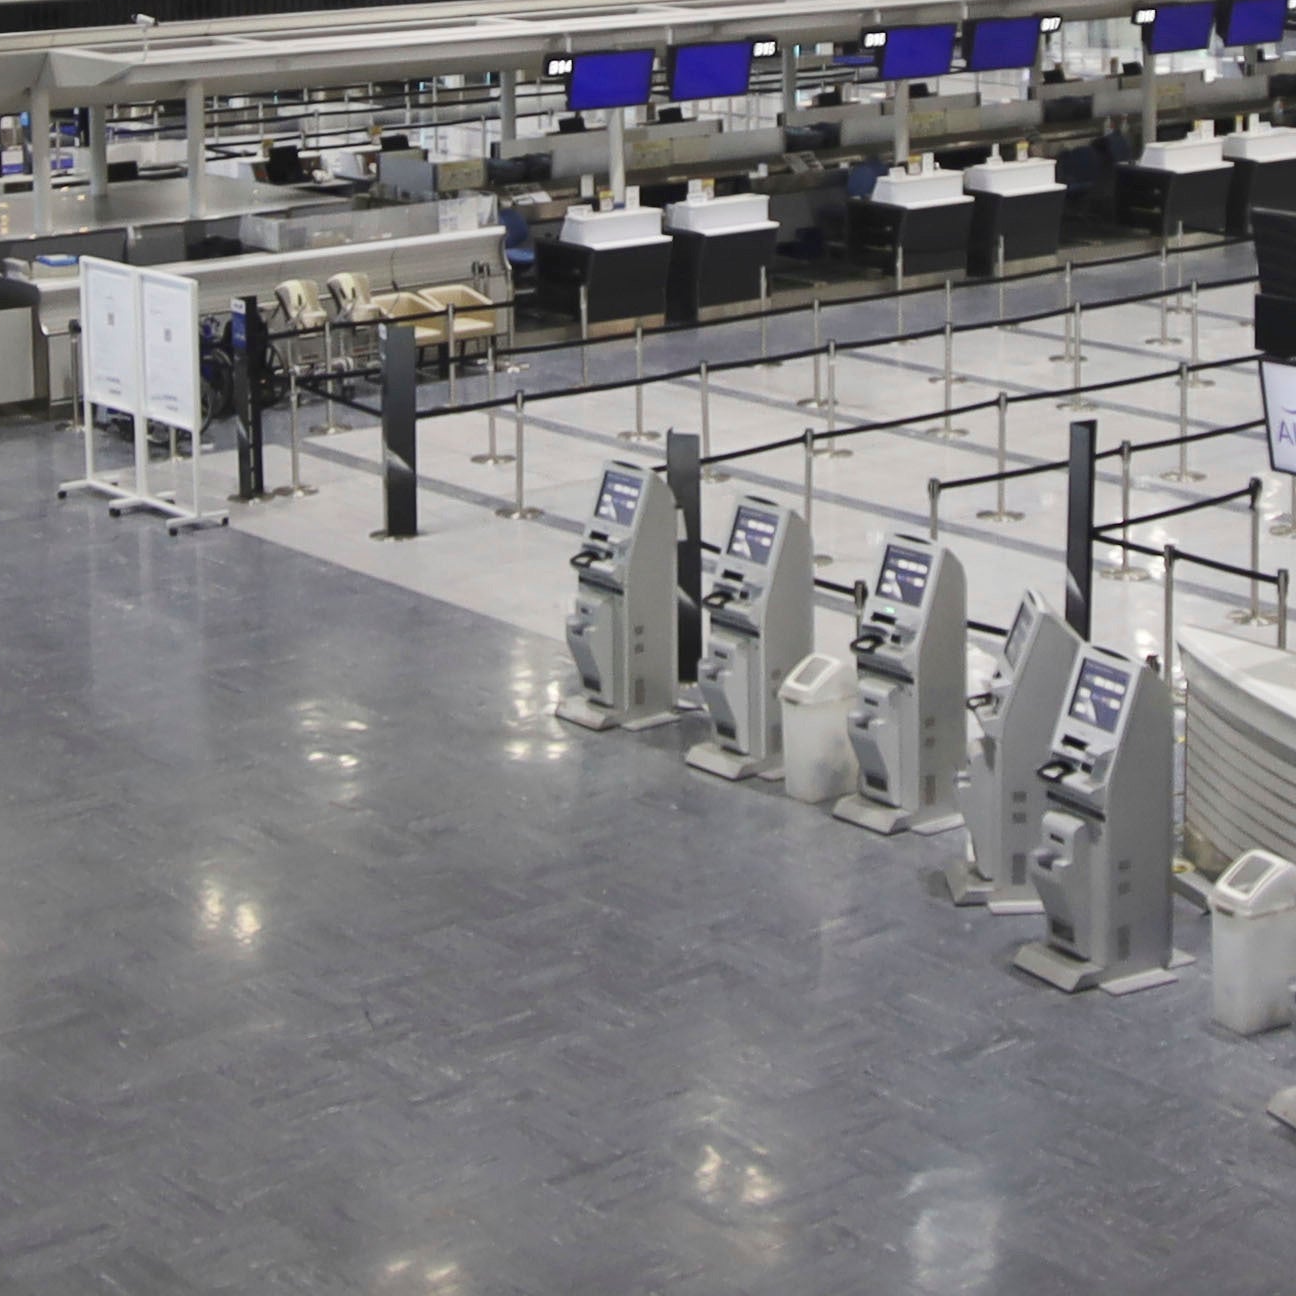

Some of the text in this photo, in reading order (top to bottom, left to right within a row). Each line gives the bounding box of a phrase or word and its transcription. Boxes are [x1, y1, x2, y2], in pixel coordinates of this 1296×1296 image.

[1040, 17, 1061, 33] B17
[753, 41, 776, 58] B15
[548, 59, 572, 76] B14
